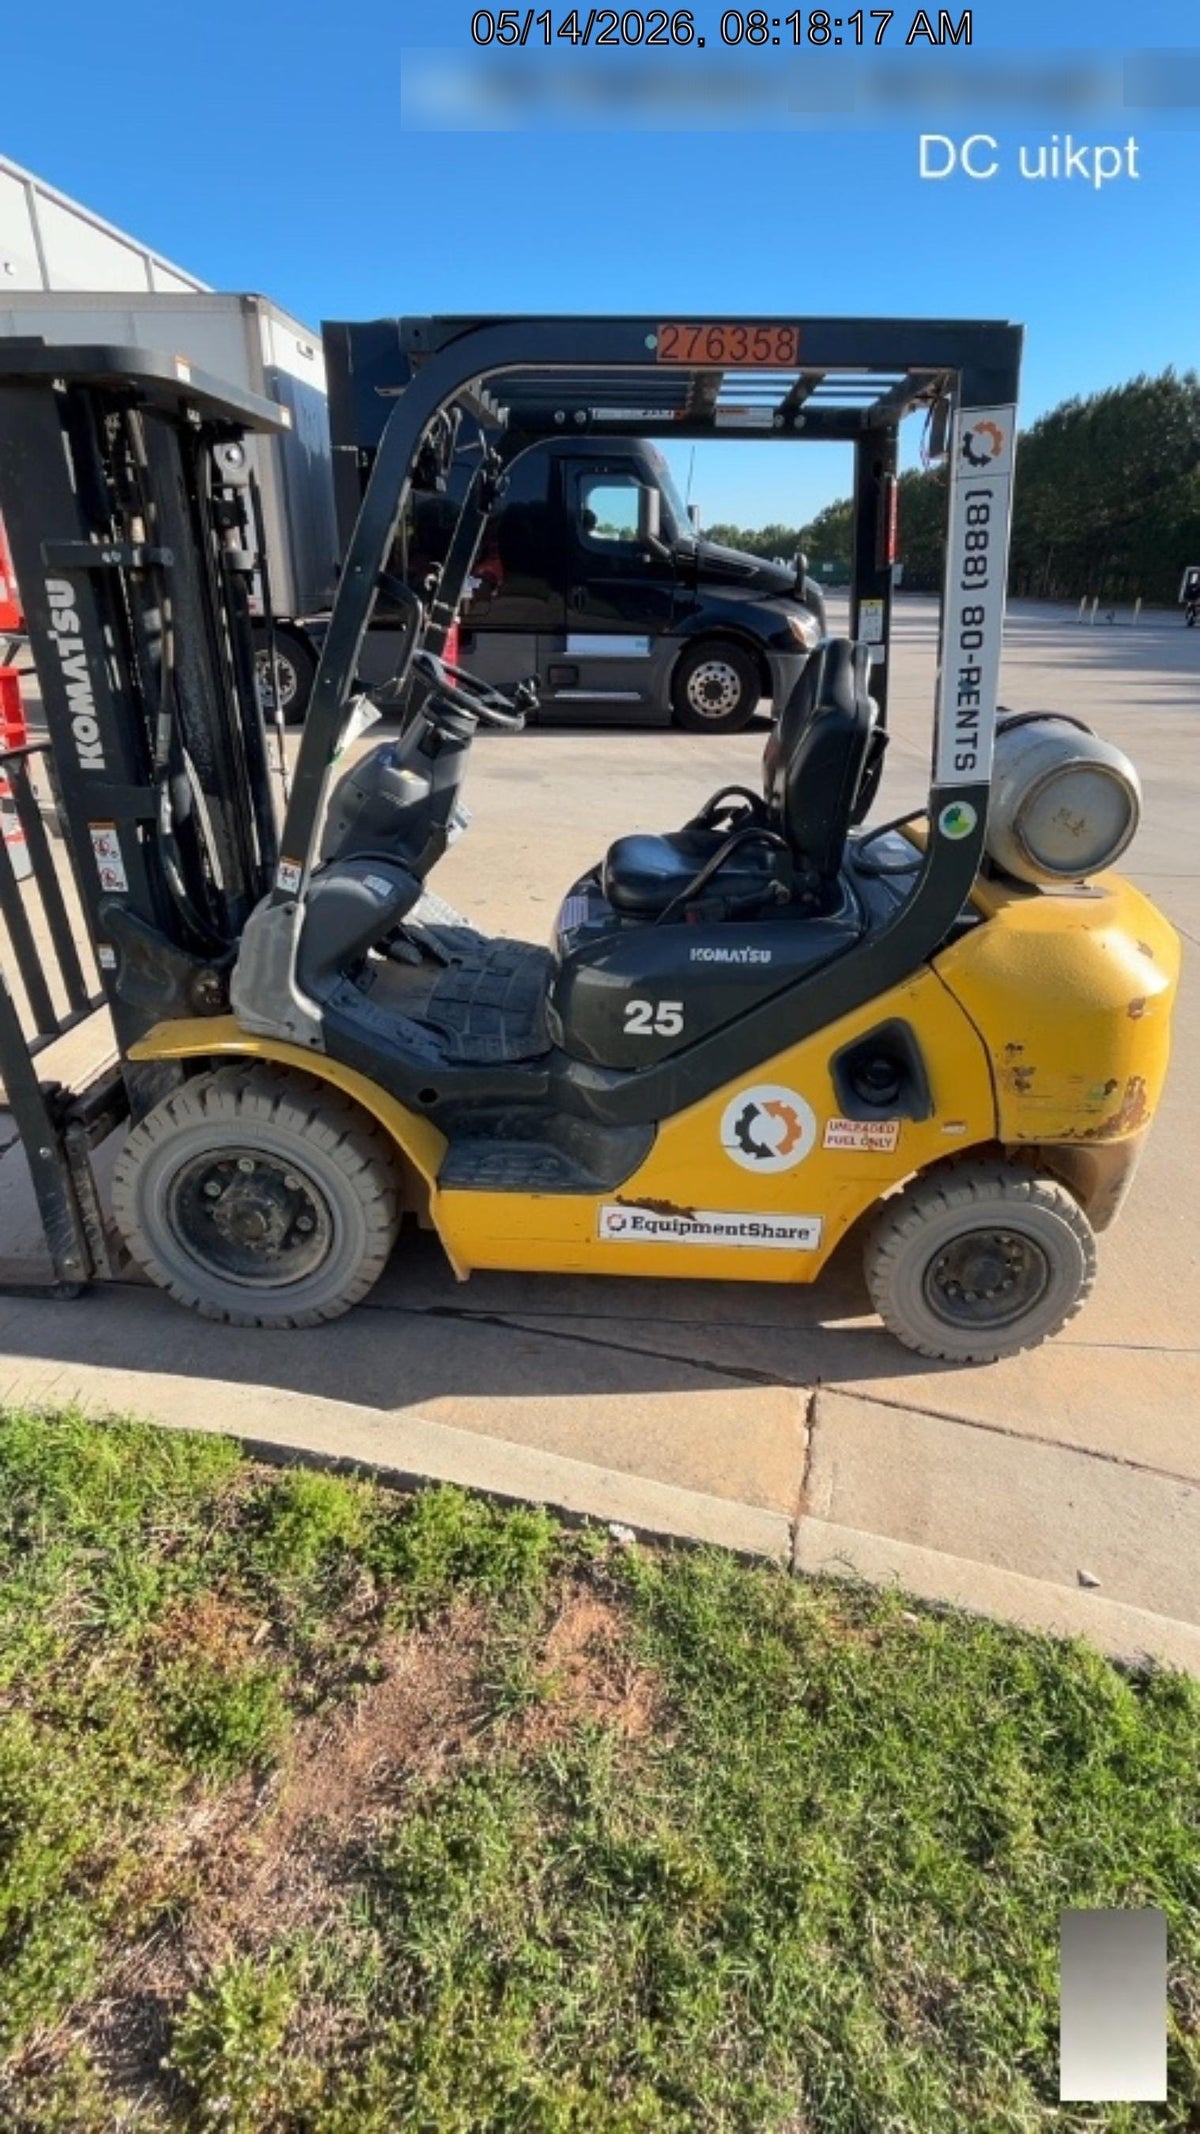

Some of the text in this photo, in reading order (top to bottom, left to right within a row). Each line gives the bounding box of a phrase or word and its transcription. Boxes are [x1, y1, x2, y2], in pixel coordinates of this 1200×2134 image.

[659, 325, 796, 363] 276358
[953, 488, 993, 773] (888) 80-RENTS
[44, 578, 106, 770] KOMATSU
[689, 946, 772, 964] KOMATSU
[623, 1000, 684, 1036] 25
[826, 1135, 893, 1148] FUEL ONLY
[829, 1120, 895, 1134] UNLEADED
[630, 1215, 811, 1241] EquipmentShare
